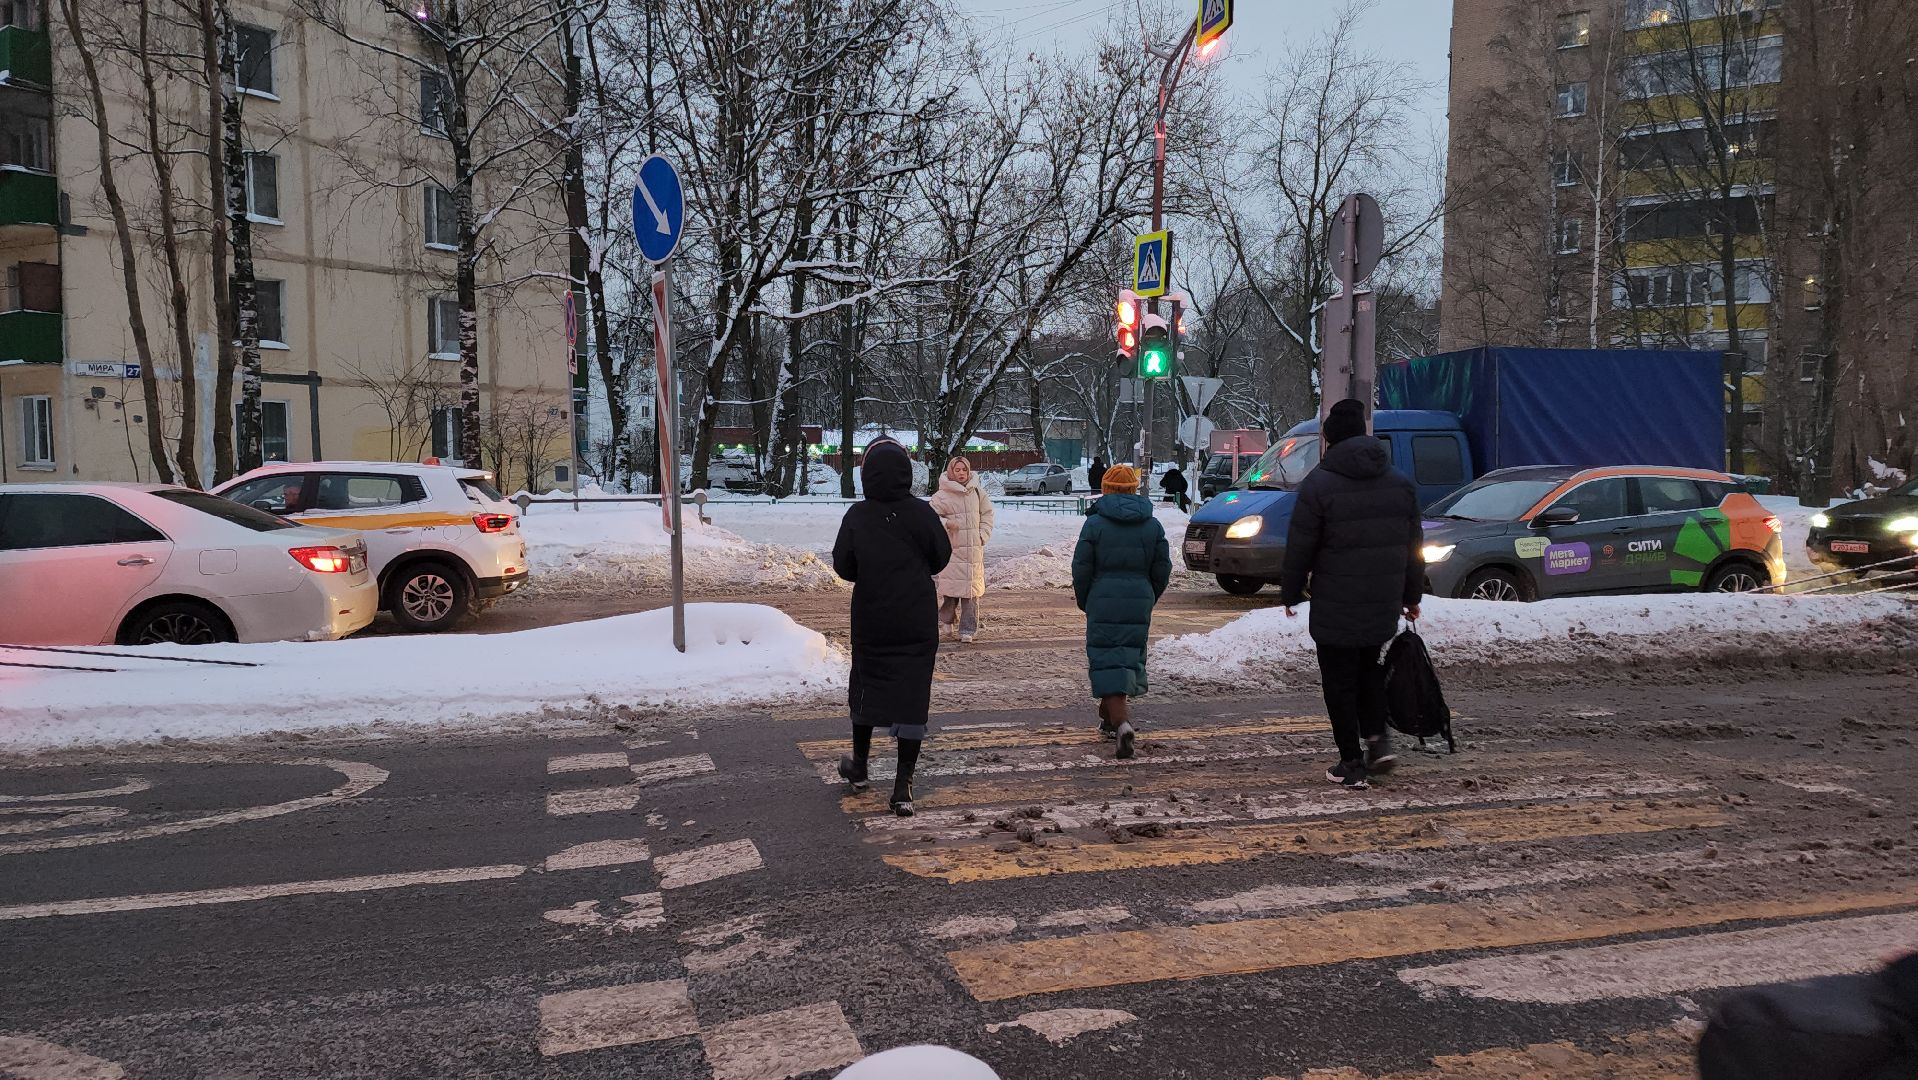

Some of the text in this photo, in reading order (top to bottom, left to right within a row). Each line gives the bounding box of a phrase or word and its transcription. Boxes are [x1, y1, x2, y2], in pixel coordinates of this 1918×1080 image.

[88, 364, 140, 376] МИРА 27
[1628, 540, 1662, 552] СИТИ
